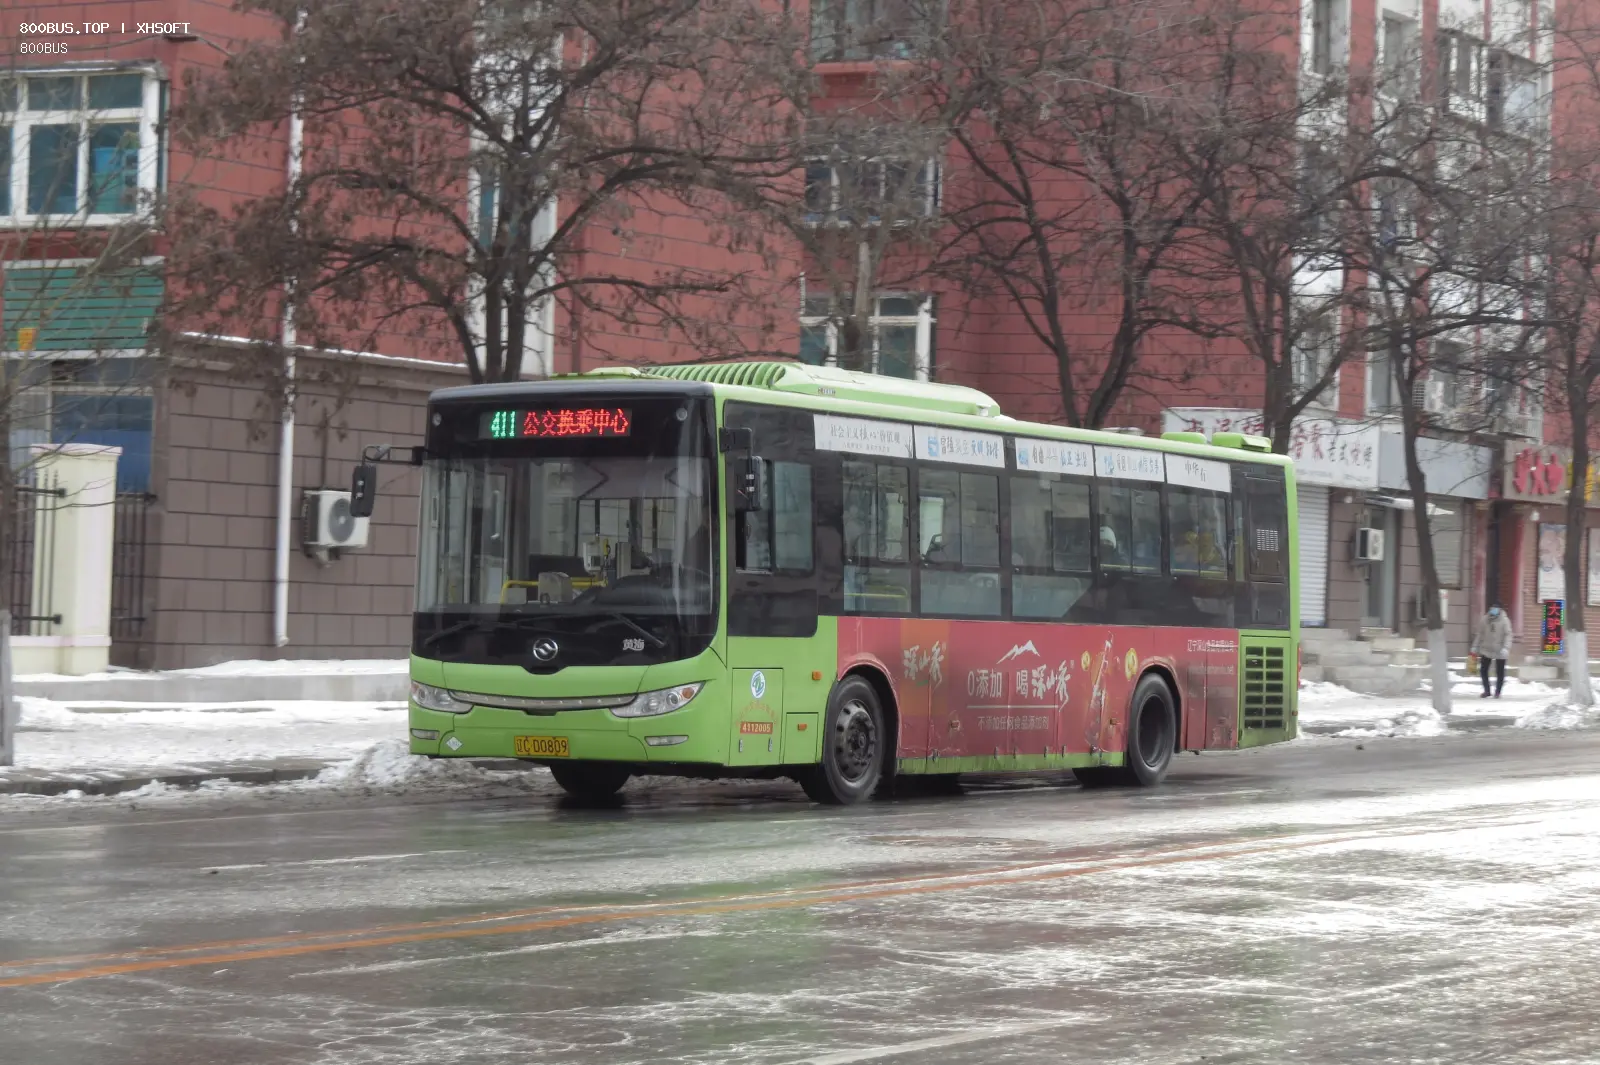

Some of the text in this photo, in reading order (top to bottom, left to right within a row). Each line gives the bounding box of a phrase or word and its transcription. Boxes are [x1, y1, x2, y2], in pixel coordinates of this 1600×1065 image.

[491, 408, 629, 437] 411 公交换乘中心
[622, 638, 645, 651] 黄海
[967, 668, 1002, 699] 0添加
[742, 723, 771, 733] 4112005
